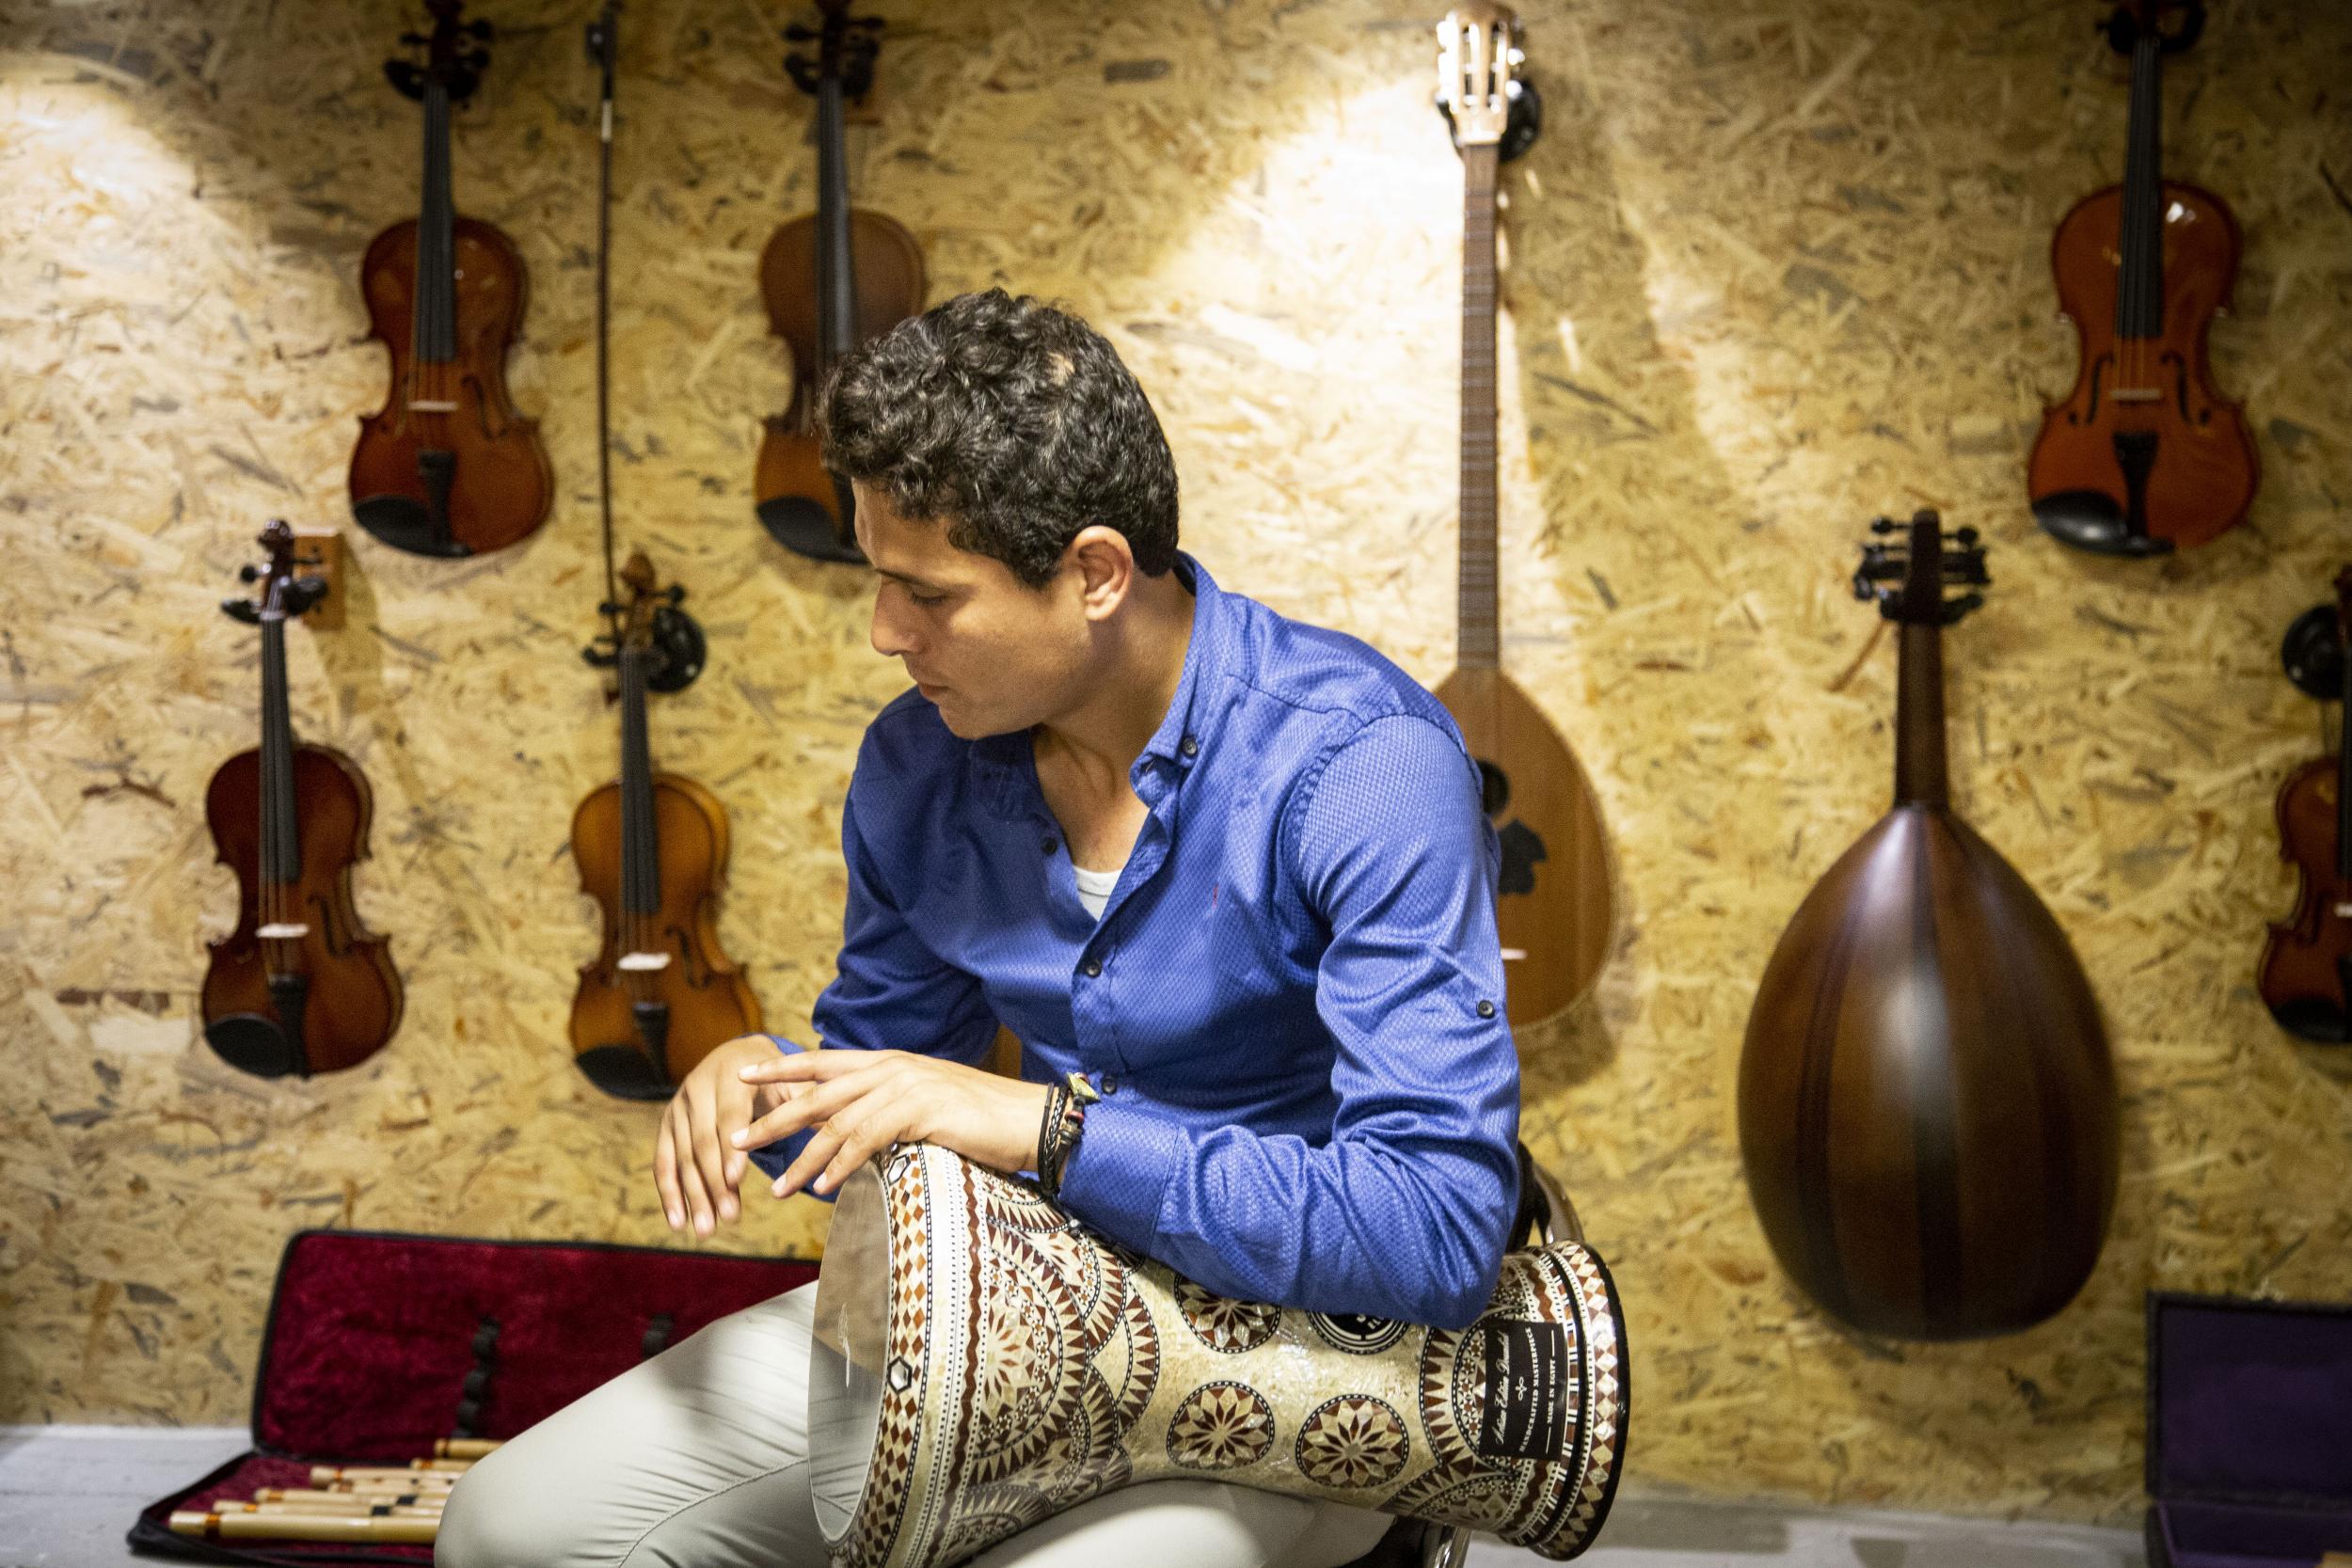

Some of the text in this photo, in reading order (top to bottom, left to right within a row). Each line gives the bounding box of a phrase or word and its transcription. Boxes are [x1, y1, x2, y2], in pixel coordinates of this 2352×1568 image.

[1518, 1327, 1539, 1452] HANDCRAFTED MASTERPIECE
[1549, 1387, 1554, 1398] IN
